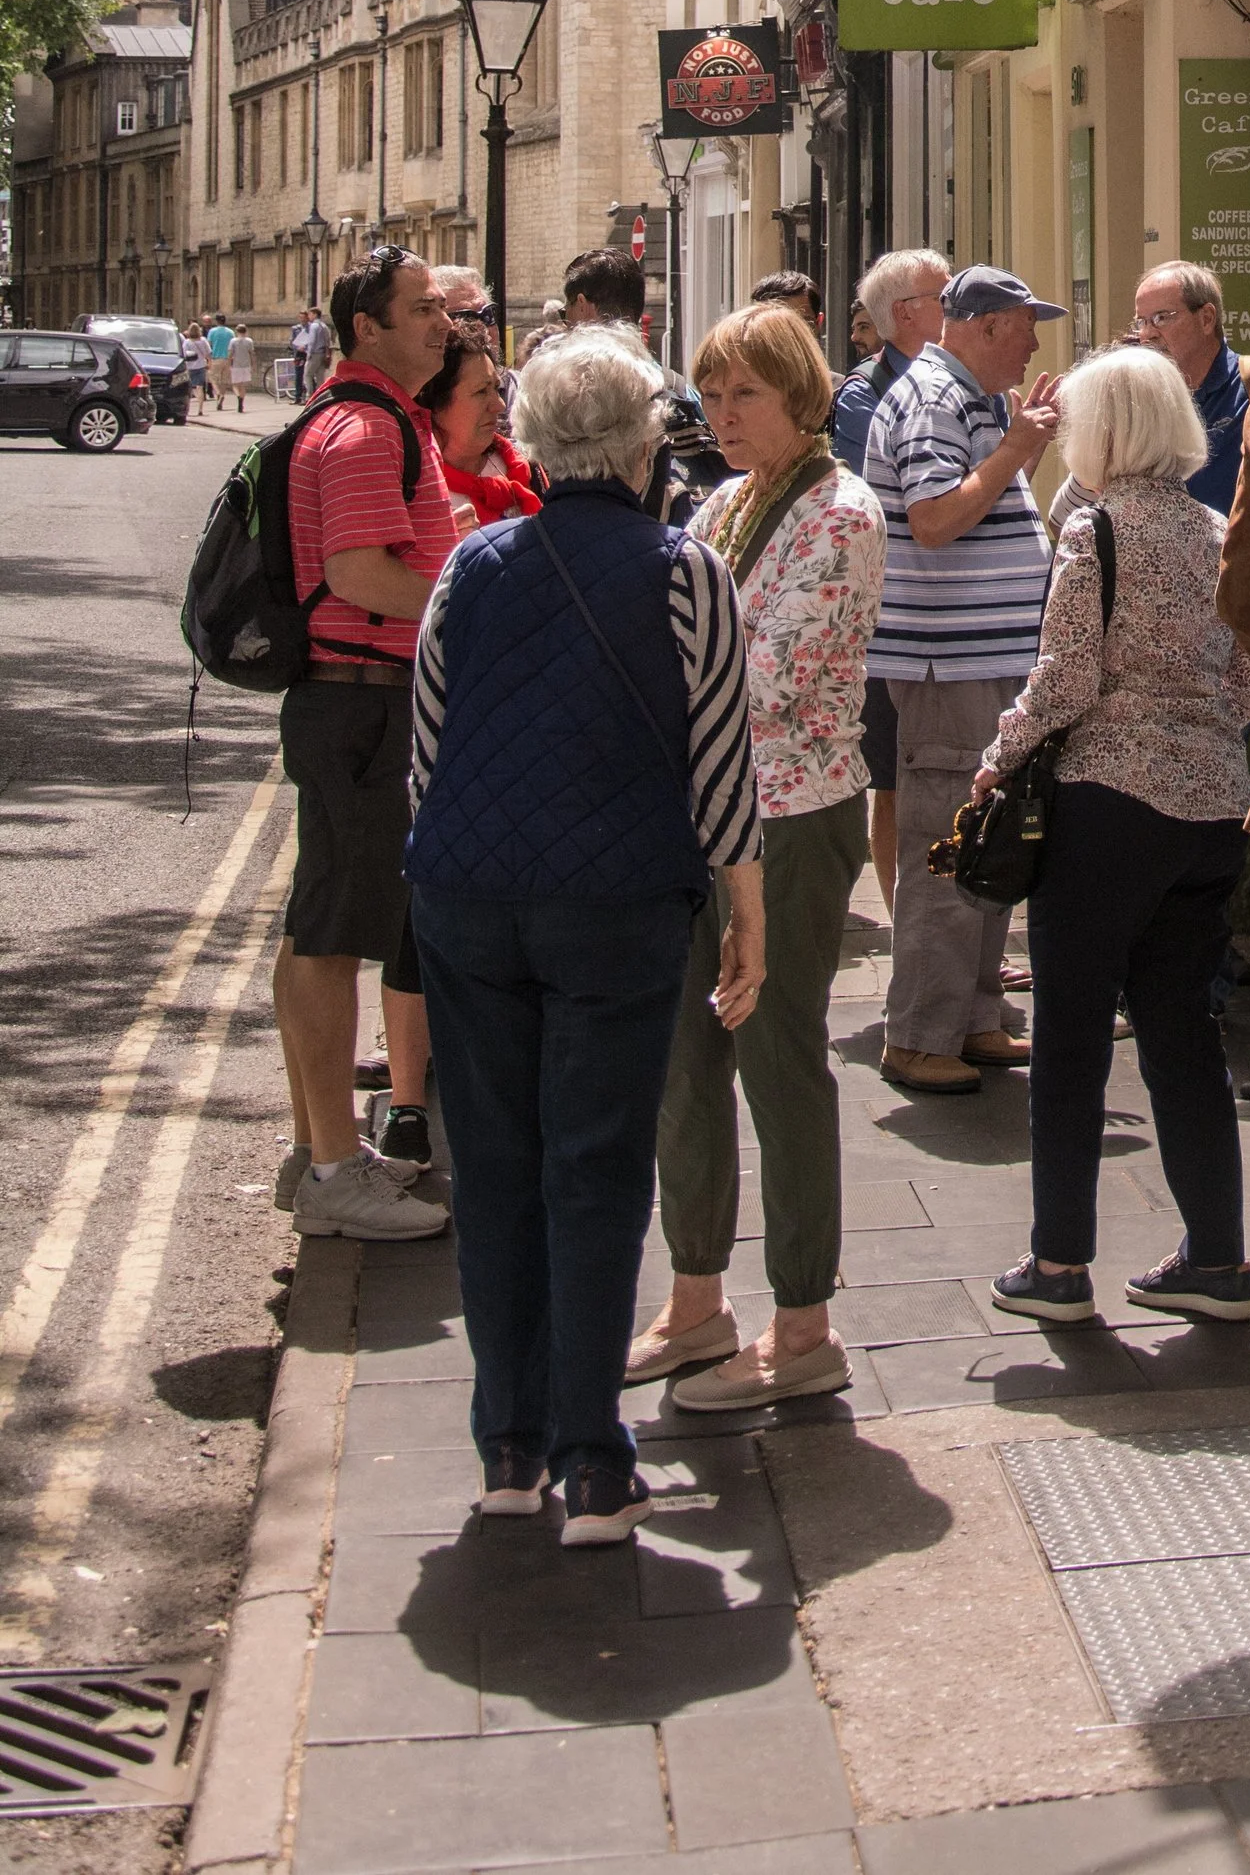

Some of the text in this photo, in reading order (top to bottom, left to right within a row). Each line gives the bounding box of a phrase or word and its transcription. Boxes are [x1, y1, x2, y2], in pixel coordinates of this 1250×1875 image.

[683, 42, 759, 72] NOT JUST
[673, 77, 772, 103] N.J.F.
[701, 107, 744, 123] FOOD
[1211, 244, 1250, 257] CAKES
